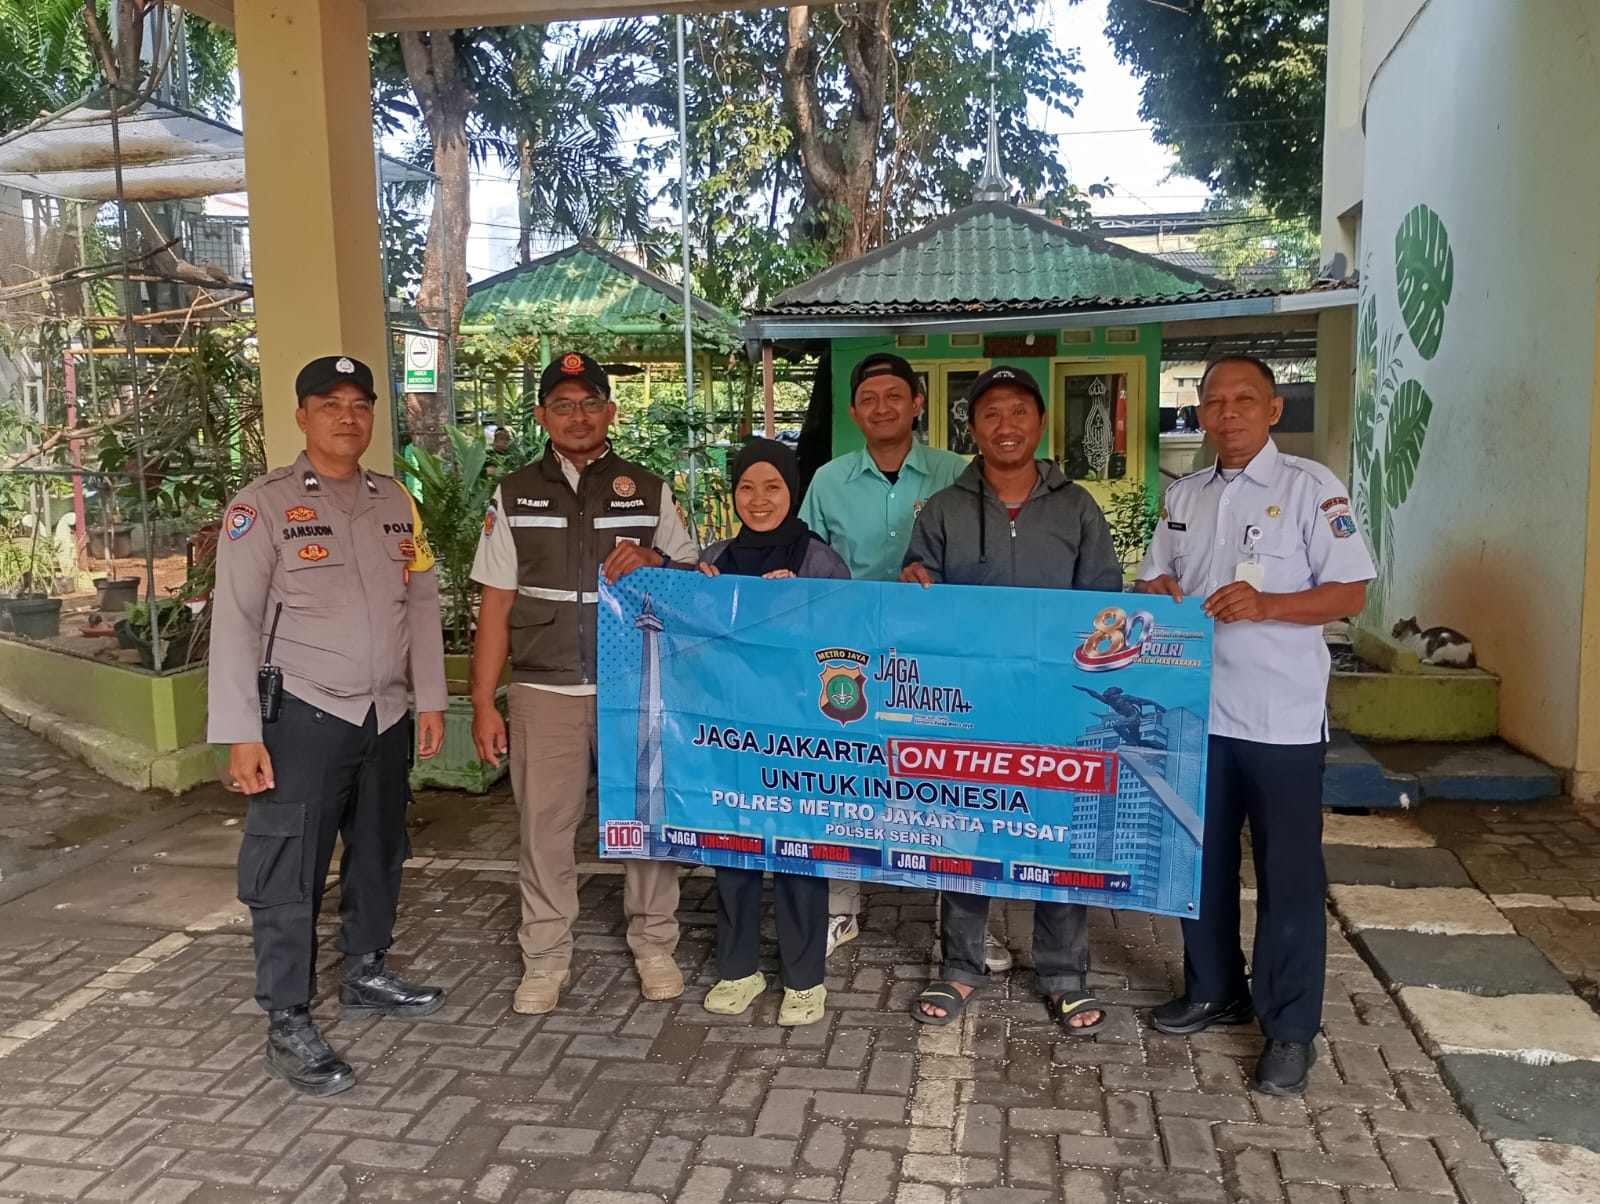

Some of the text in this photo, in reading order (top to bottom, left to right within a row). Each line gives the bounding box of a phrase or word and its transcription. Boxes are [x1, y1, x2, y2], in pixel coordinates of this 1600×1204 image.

[516, 497, 549, 508] YASMIN
[610, 499, 644, 509] ANGGOTA
[283, 525, 333, 540] SAMSUDIN
[1083, 606, 1154, 658] 80
[818, 651, 867, 663] METRO JAYA
[1141, 643, 1184, 657] POLRI
[874, 651, 920, 684] JAGA
[693, 724, 1101, 784] JAGA JAKARTA ON THE SPOT
[761, 767, 1030, 814] UNTUK INDONESIA
[712, 790, 1071, 843] POLRES METRO JAKARTA PUSAT
[608, 828, 641, 845] 110
[671, 830, 762, 853] JAGA LINGKUNGAN
[826, 823, 943, 846] POLSEK SENEN
[781, 841, 850, 861] JAGA WARGA
[897, 853, 973, 875] JAGA ATURAN
[1020, 866, 1105, 888] JAGA AMANAH
